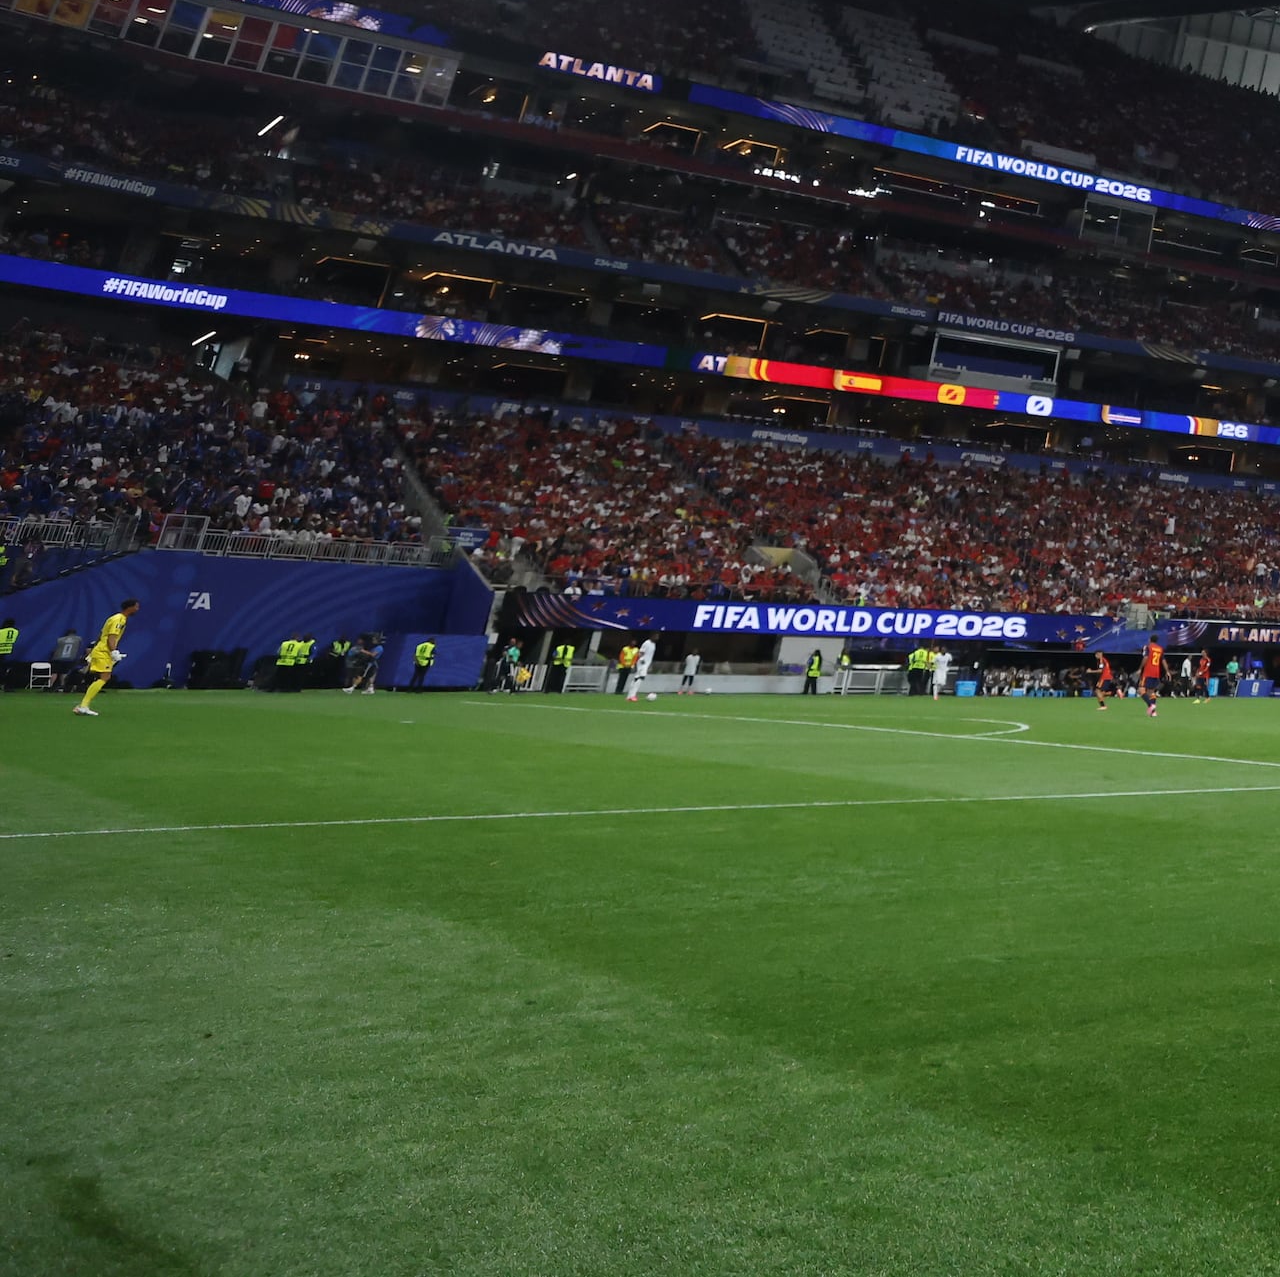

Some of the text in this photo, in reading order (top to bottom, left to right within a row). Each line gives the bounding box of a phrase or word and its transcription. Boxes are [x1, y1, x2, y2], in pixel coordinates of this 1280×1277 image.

[538, 50, 655, 92] ATLANTA
[64, 167, 157, 197] #FIFAWorldCup
[956, 145, 1153, 203] FIFA WORLD CUP 2026
[433, 232, 559, 261] ATLANTA
[103, 277, 228, 310] #FIFAWorldCup
[937, 311, 964, 326] FIFA
[966, 316, 1010, 332] WORLD
[1010, 323, 1035, 336] CUP
[1035, 328, 1075, 343] 2026
[693, 604, 1028, 639] FIFA WORLD CUP 2026
[1152, 652, 1161, 666] 21
